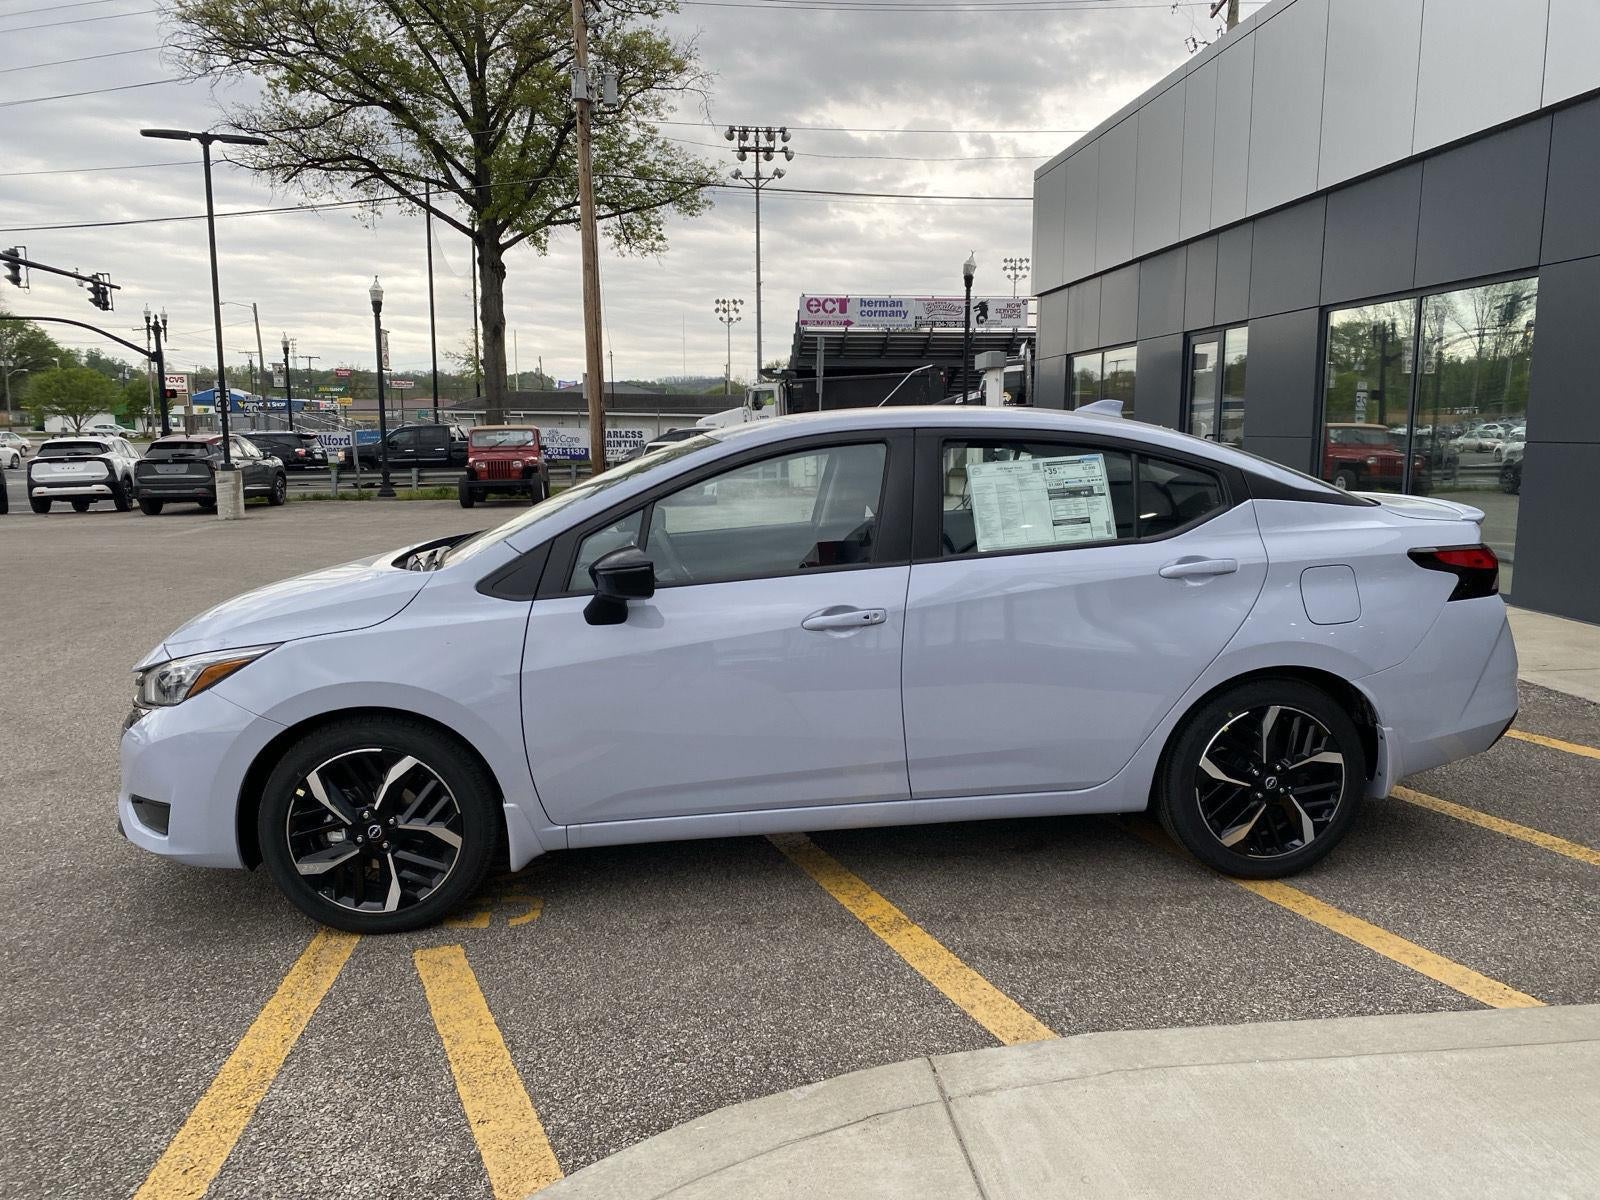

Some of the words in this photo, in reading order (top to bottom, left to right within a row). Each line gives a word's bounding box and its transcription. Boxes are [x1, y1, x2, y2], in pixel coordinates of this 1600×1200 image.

[860, 298, 902, 307] herman
[860, 309, 908, 319] cormany
[245, 405, 259, 413] 60
[606, 430, 643, 439] ARLESS
[606, 440, 645, 448] RINTING
